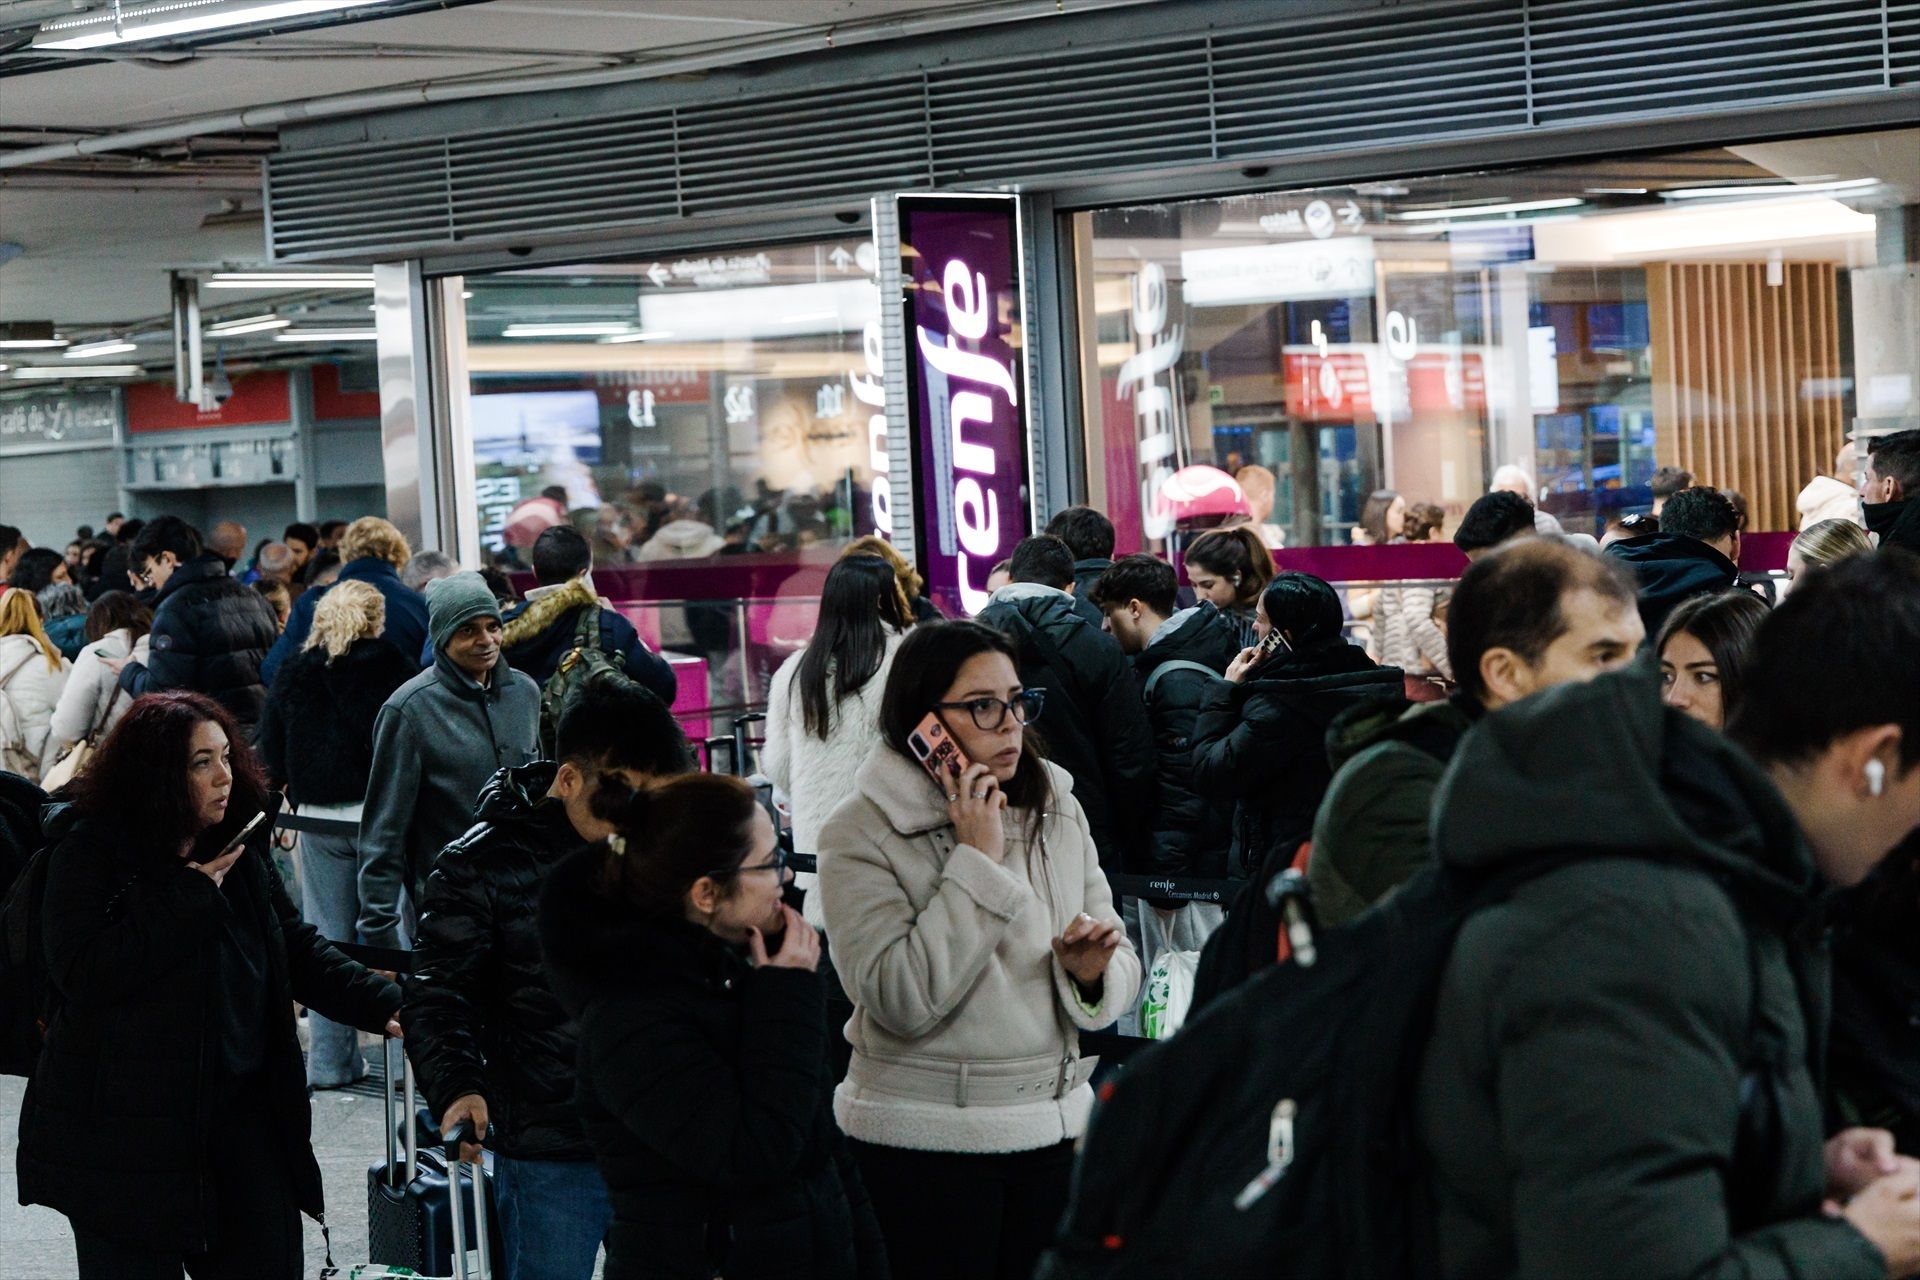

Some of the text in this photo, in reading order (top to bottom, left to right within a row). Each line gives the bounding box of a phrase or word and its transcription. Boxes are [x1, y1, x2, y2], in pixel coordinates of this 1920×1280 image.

[917, 259, 1017, 616] renfe
[1150, 879, 1175, 893] renfe
[1193, 891, 1212, 900] Madrid
